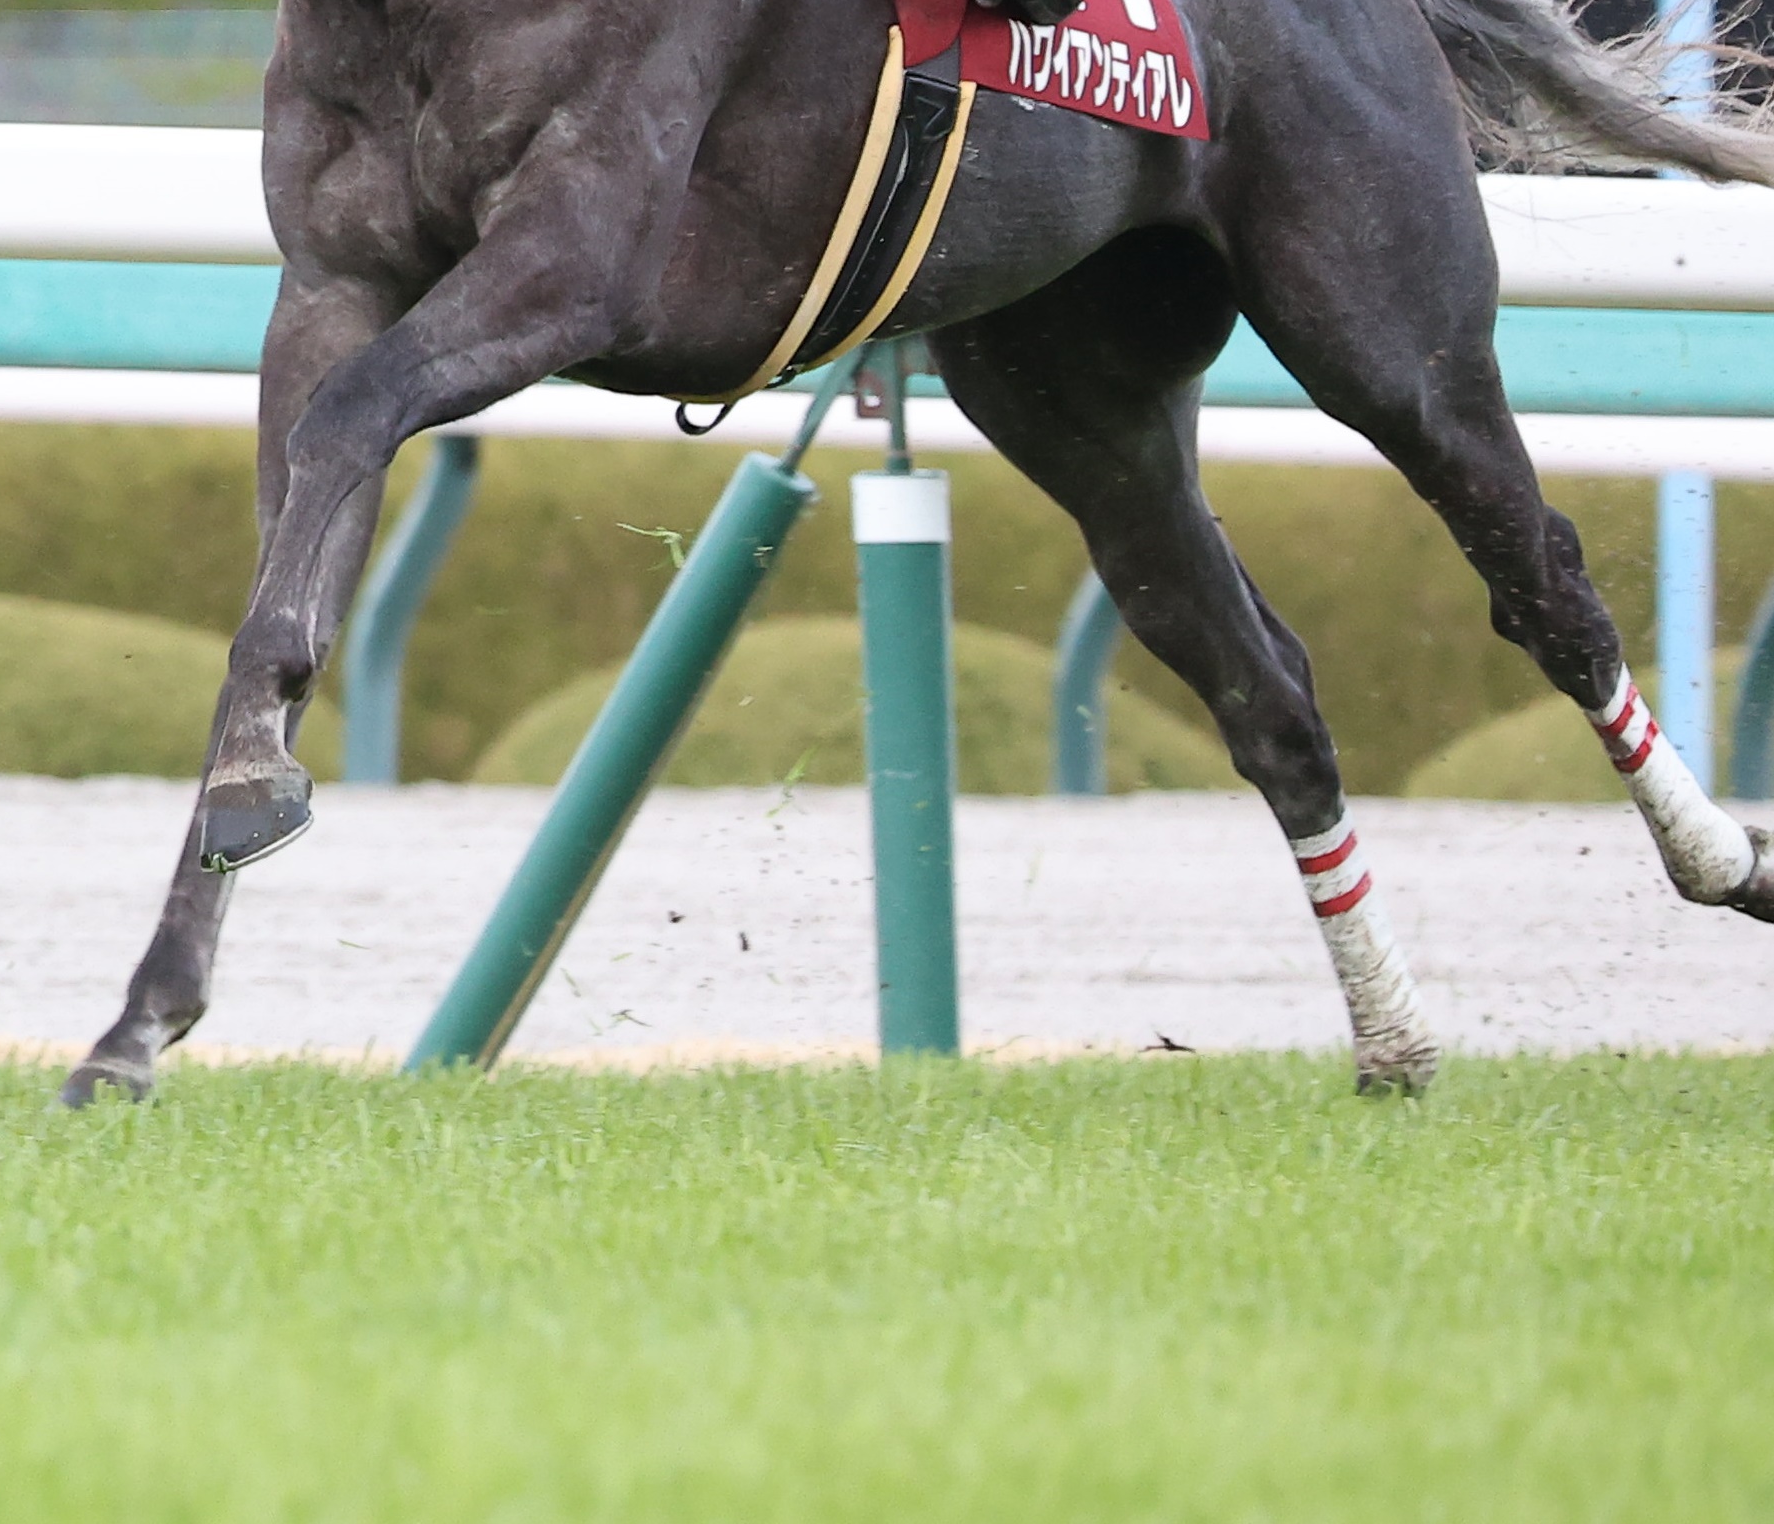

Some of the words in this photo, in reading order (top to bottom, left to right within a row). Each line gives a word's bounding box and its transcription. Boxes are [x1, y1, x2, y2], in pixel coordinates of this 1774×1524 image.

[1008, 18, 1193, 128] ハワイアンティアレ
